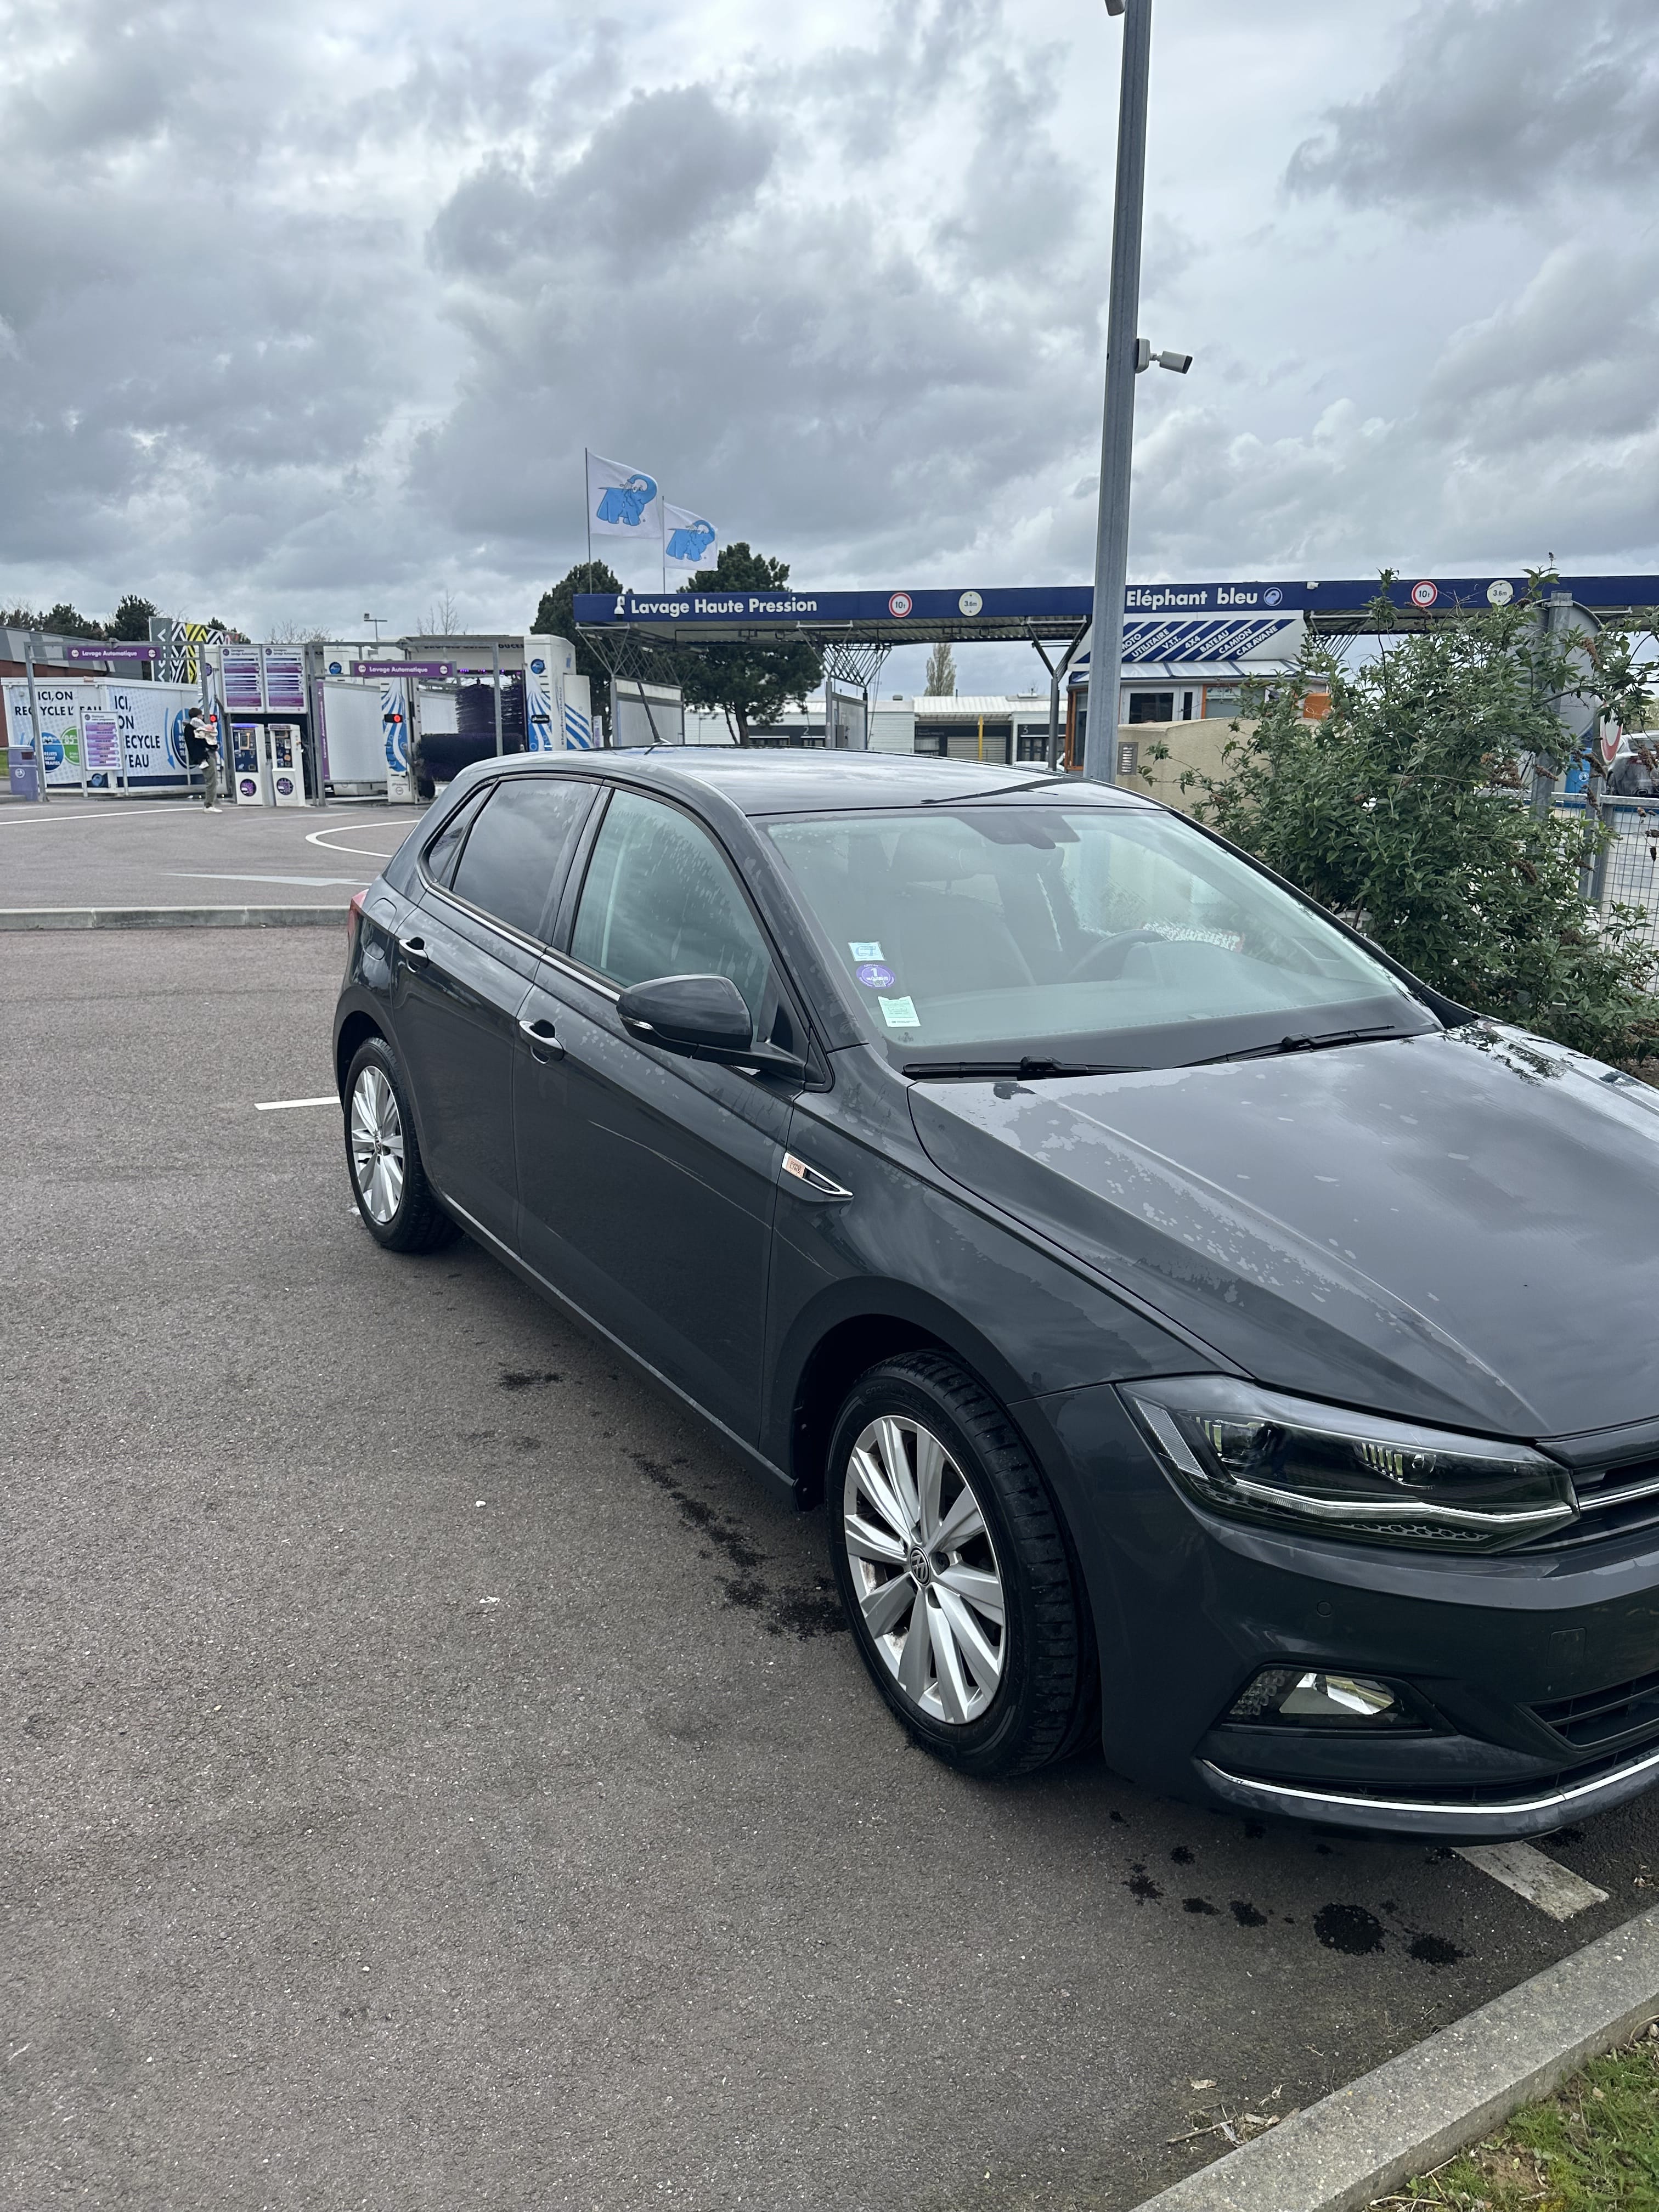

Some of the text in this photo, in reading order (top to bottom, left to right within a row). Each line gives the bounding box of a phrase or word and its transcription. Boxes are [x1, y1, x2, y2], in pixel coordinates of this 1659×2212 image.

[631, 597, 817, 617] Lavage Haute Pression
[1126, 588, 1258, 610] Eléphant bleu
[1131, 629, 1170, 658] UTILITAIRE
[1184, 635, 1201, 649] 4X4
[1199, 630, 1229, 653] BATEAU
[1218, 628, 1252, 654] CAMION
[1236, 625, 1278, 656] CARAVANE
[115, 696, 132, 712] ICI,
[119, 715, 134, 730] ON
[803, 726, 809, 735] 2
[1023, 725, 1029, 734] 3
[123, 735, 161, 749] ECYCLE
[871, 968, 878, 977] 1
